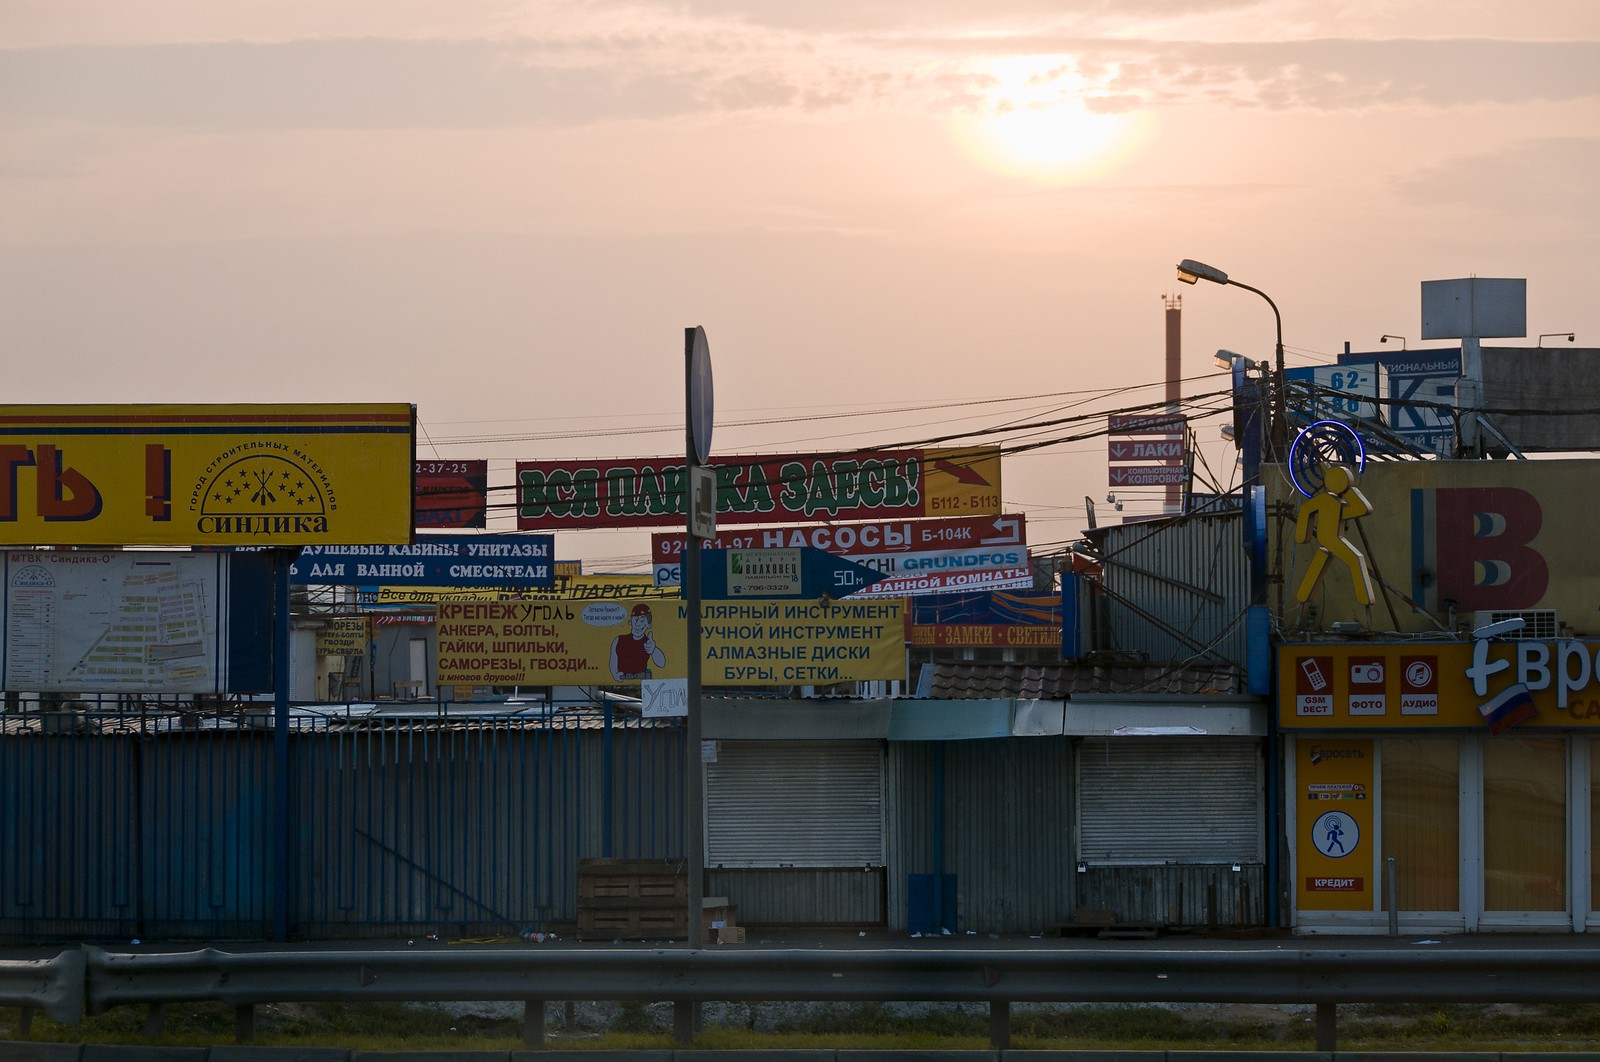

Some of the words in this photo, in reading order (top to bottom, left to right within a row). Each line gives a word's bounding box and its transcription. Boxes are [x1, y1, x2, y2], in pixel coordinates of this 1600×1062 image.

[1132, 443, 1181, 457] ЛАКИ
[190, 476, 207, 511] ГОРОД
[206, 441, 289, 474] СТРОИТЕЛЬНЫХ
[293, 449, 337, 511] МАТЕРИАЛОВ
[1128, 475, 1186, 484] КОЛЕРОВКА
[519, 468, 601, 518] ВСЯ
[605, 464, 776, 516] ПЛИКА
[780, 458, 920, 517] ЗДЕСЬ!
[932, 496, 960, 510] Б112
[971, 495, 999, 508] Б113
[763, 524, 912, 549] НАСОСЫ
[922, 527, 972, 542] Б-104К
[301, 545, 385, 556] ДУШЕВЫЕ
[388, 544, 459, 556] КАБИНЫ
[467, 543, 548, 557] УНИТАЗЫ
[11, 554, 42, 563] МТВК
[903, 553, 1019, 570] GRUNDFOS
[309, 563, 345, 577] ДЛЯ
[357, 562, 425, 577] ВАННОЙ
[449, 565, 548, 578] СМЕСИТЕЛИ
[745, 563, 797, 575] ВОЛХОВЕЦ
[872, 576, 940, 593] ВАННОЙ
[946, 568, 1030, 586] КОМНАТЫ
[380, 588, 405, 600] Все
[409, 589, 434, 602] для
[572, 584, 653, 599] ПАРКЕТ
[439, 602, 518, 619] КРЕПЁЖ
[785, 605, 900, 619] ИНСТРУМЕНТ
[439, 625, 499, 638] АНКЕРА,
[503, 625, 559, 638] БОЛТЫ,
[769, 625, 884, 639] ИНСТРУМЕНТ
[945, 626, 994, 645] ЗАМКИ
[439, 639, 488, 655] ГАЙКИ,
[492, 641, 568, 655] ШПИЛЬКИ,
[707, 646, 807, 660] АЛМАЗНЫЕ
[812, 646, 870, 662] ДИСКИ
[439, 658, 526, 672] САМОРЕЗЫ,
[530, 658, 599, 672] ГВОЗДИ...
[483, 673, 525, 683] другое!!!
[724, 666, 778, 682] БУРЫ,
[783, 666, 853, 680] СЕТКИ...
[644, 682, 688, 712] УГОЛ
[1351, 700, 1383, 709] ФОТО
[1402, 700, 1437, 709] АУДИО
[1314, 879, 1355, 887] КРЕДИТ
